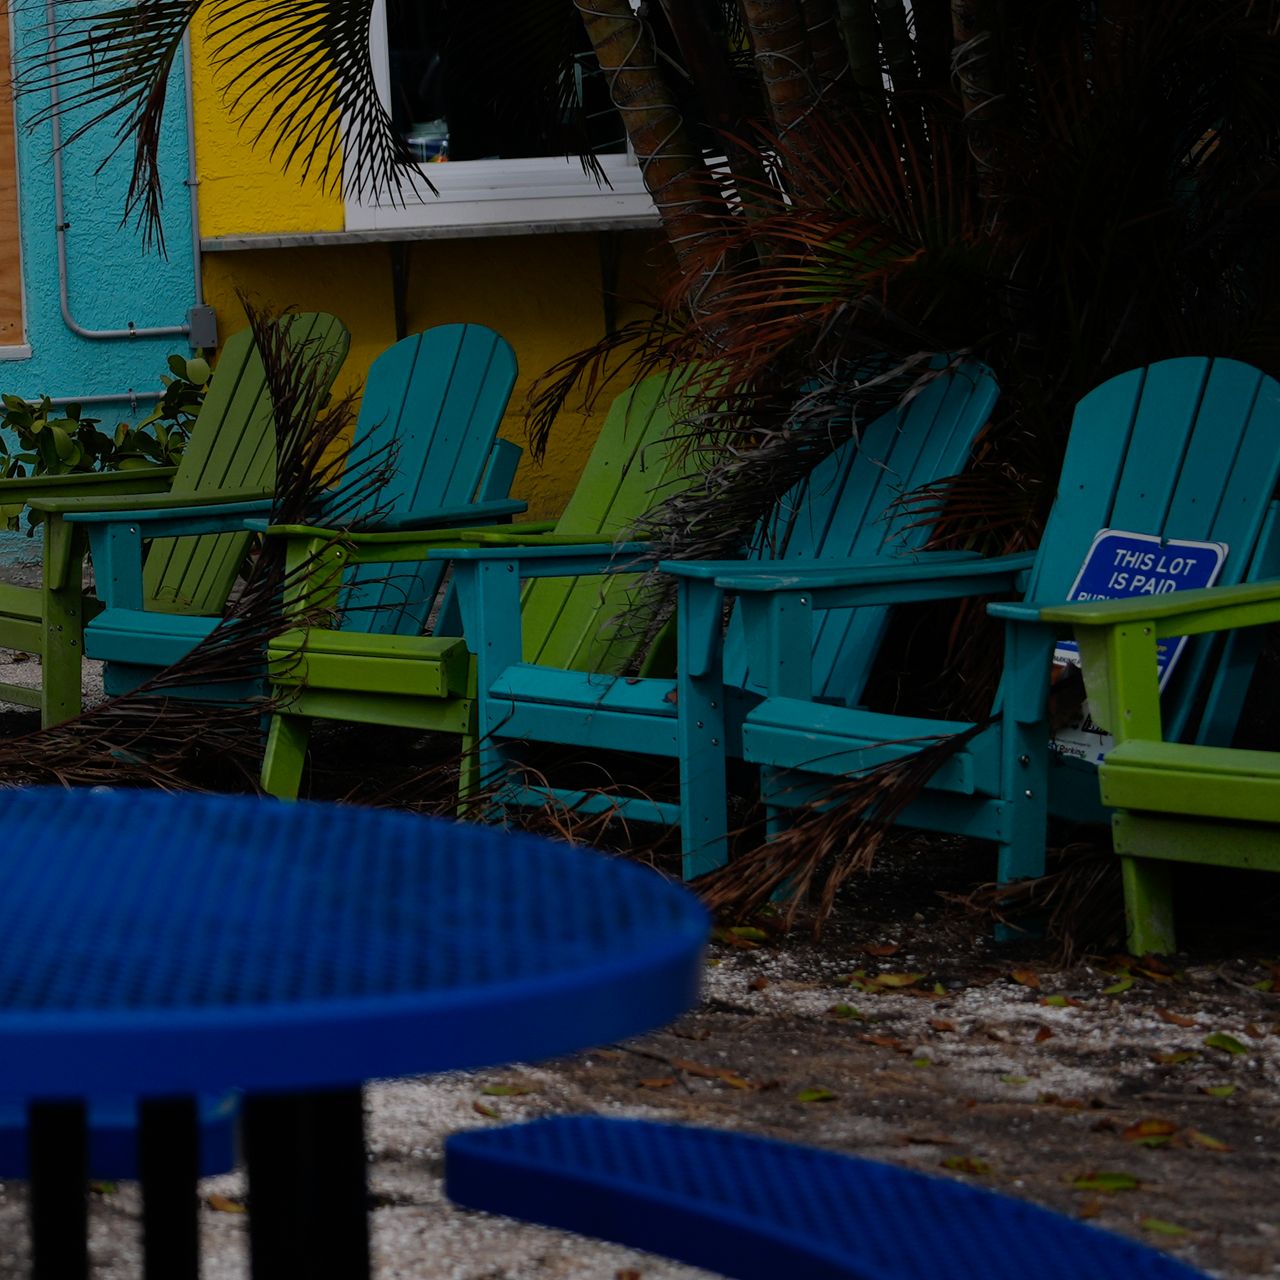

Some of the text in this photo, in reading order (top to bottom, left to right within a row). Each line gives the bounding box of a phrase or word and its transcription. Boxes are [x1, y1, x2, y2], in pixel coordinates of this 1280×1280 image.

[1113, 548, 1197, 576] THIS LOT
[1108, 571, 1177, 595] IS PAID
